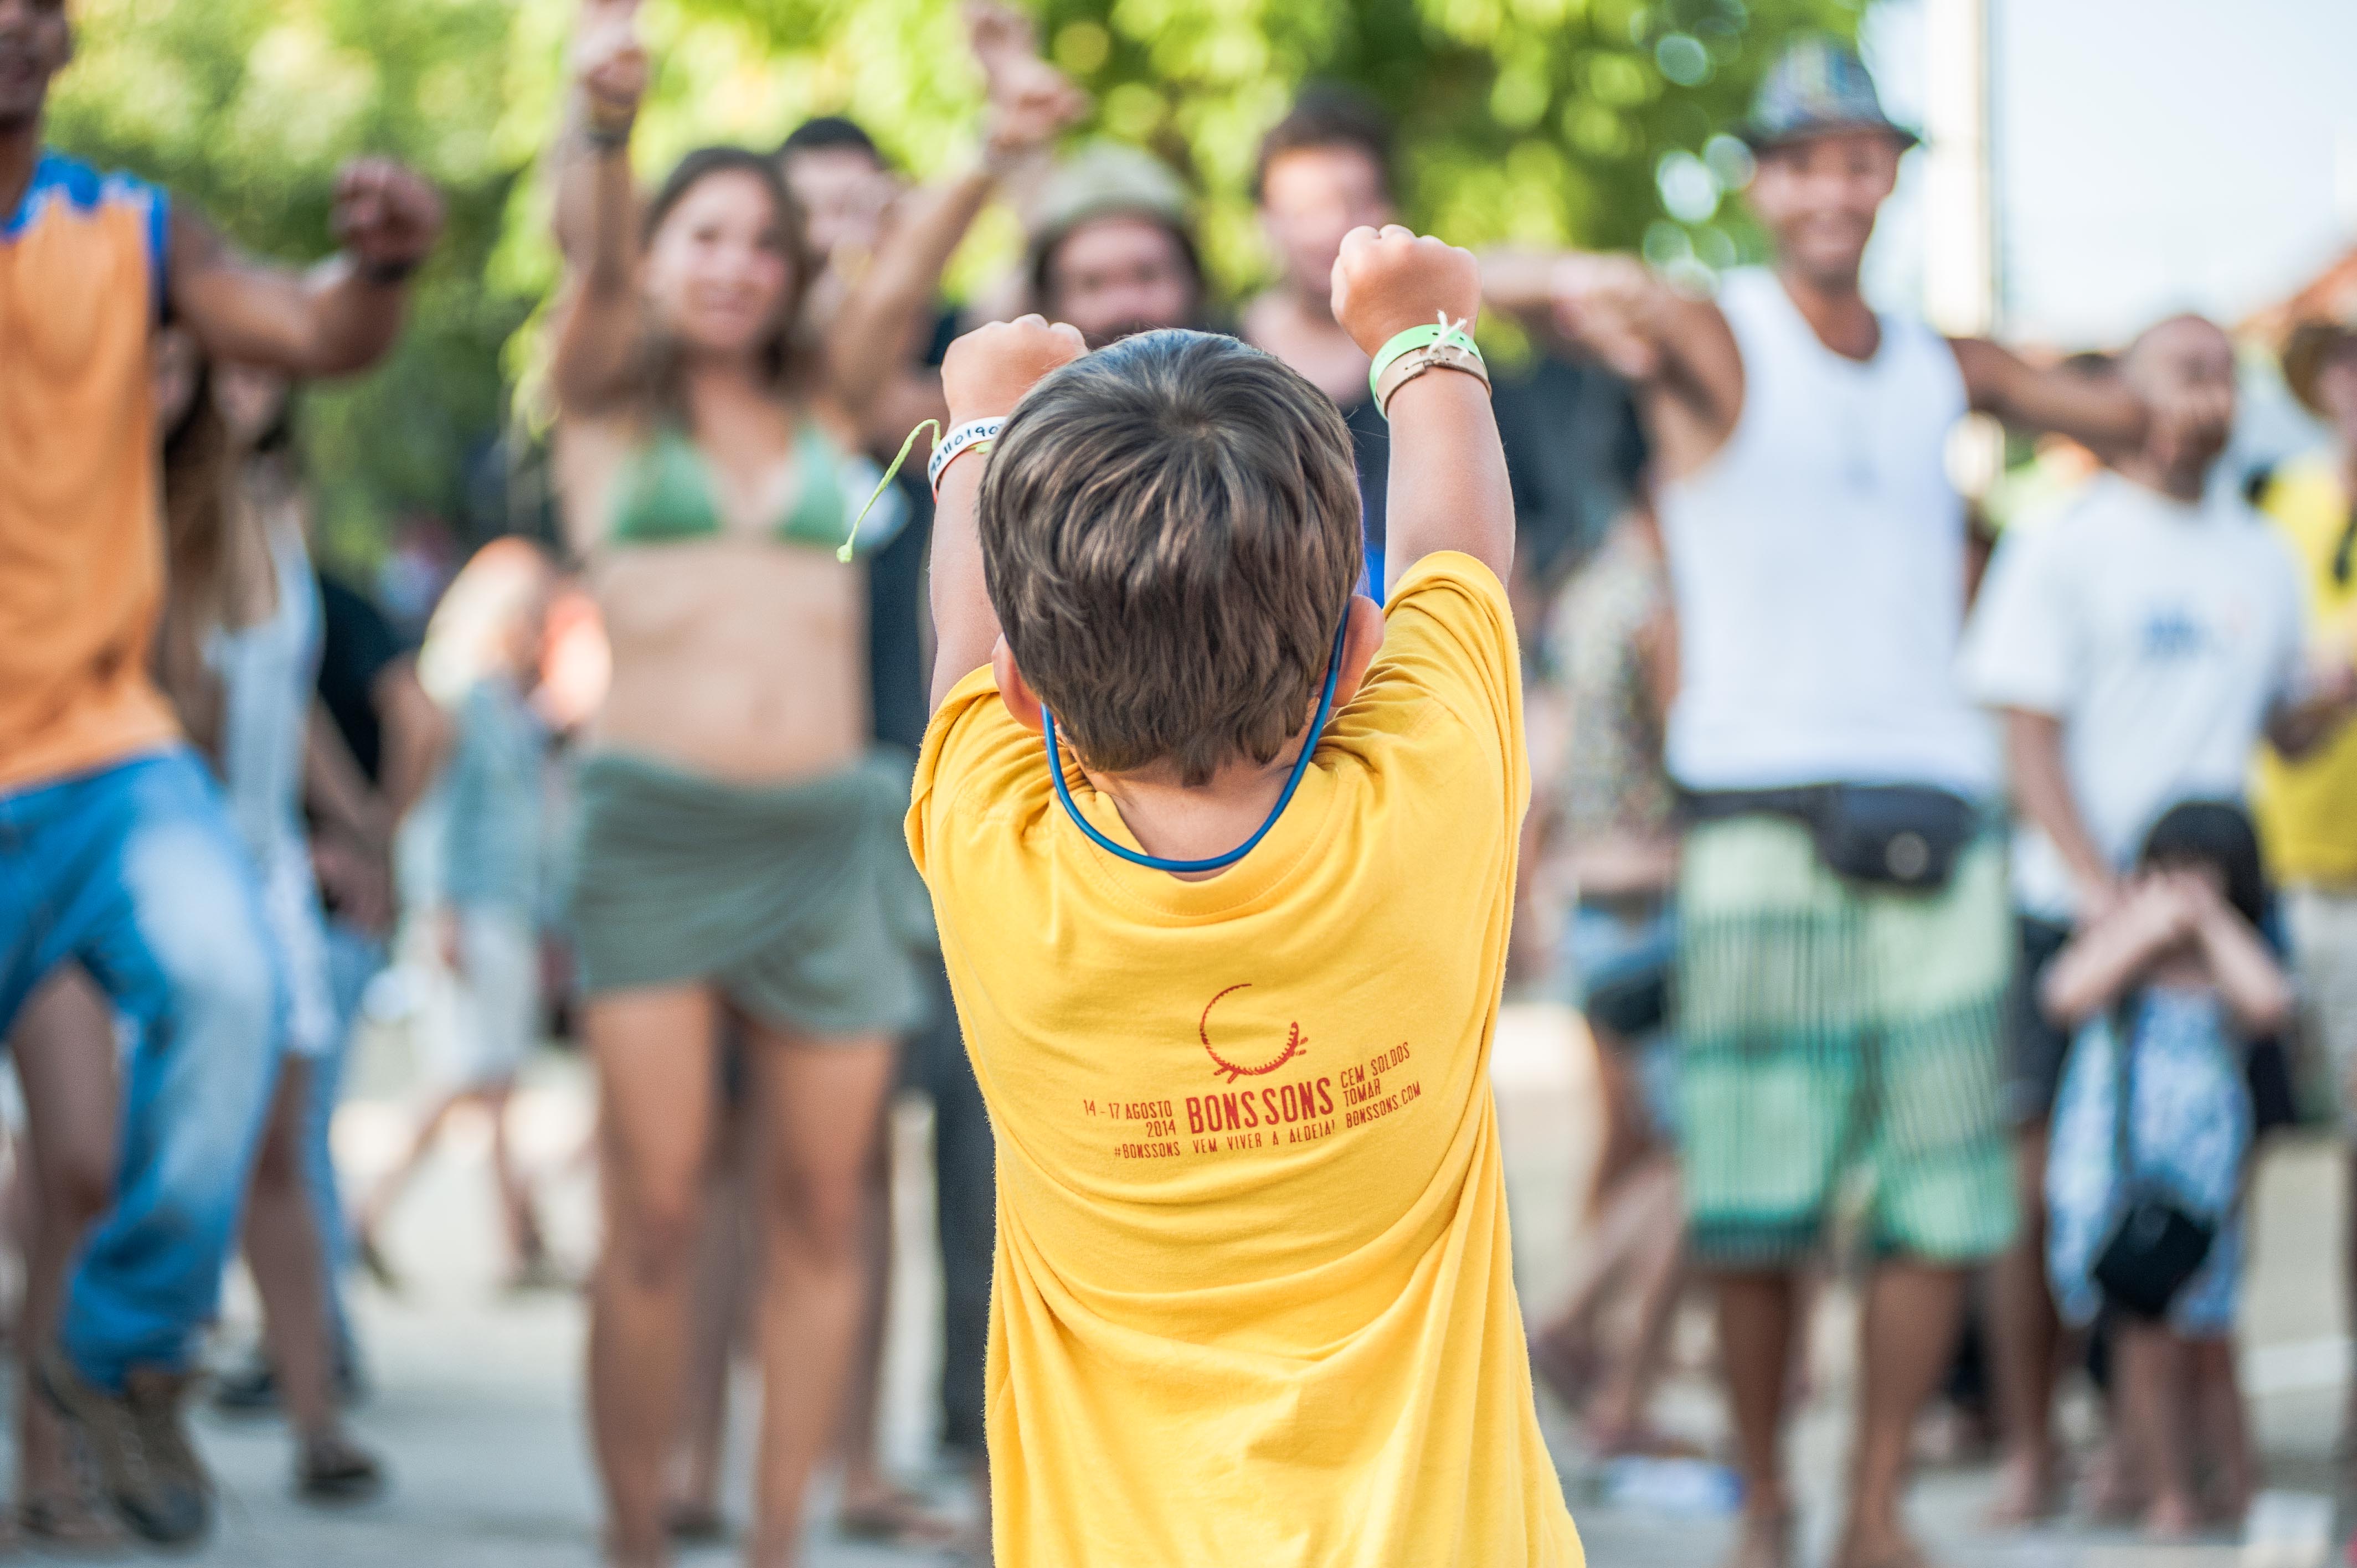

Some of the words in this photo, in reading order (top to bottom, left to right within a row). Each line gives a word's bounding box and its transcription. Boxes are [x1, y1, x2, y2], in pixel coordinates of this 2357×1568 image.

[1340, 1064, 1365, 1089] CEM
[1371, 1041, 1410, 1076] SOLDOS
[1083, 1098, 1096, 1117] 14
[1108, 1102, 1120, 1120] 17
[1125, 1100, 1173, 1120] AGOSTO
[1186, 1077, 1334, 1134] BONSSONS
[1343, 1078, 1381, 1107] TOMAR
[1114, 1141, 1181, 1159] #BONSSONS
[1192, 1138, 1218, 1154] VEM
[1227, 1132, 1262, 1151] VIVER
[1272, 1131, 1279, 1146] A
[1289, 1119, 1336, 1143] ALDEIA!
[1346, 1080, 1421, 1128] BONSSONS.COM
[1146, 1118, 1176, 1138] 2014
